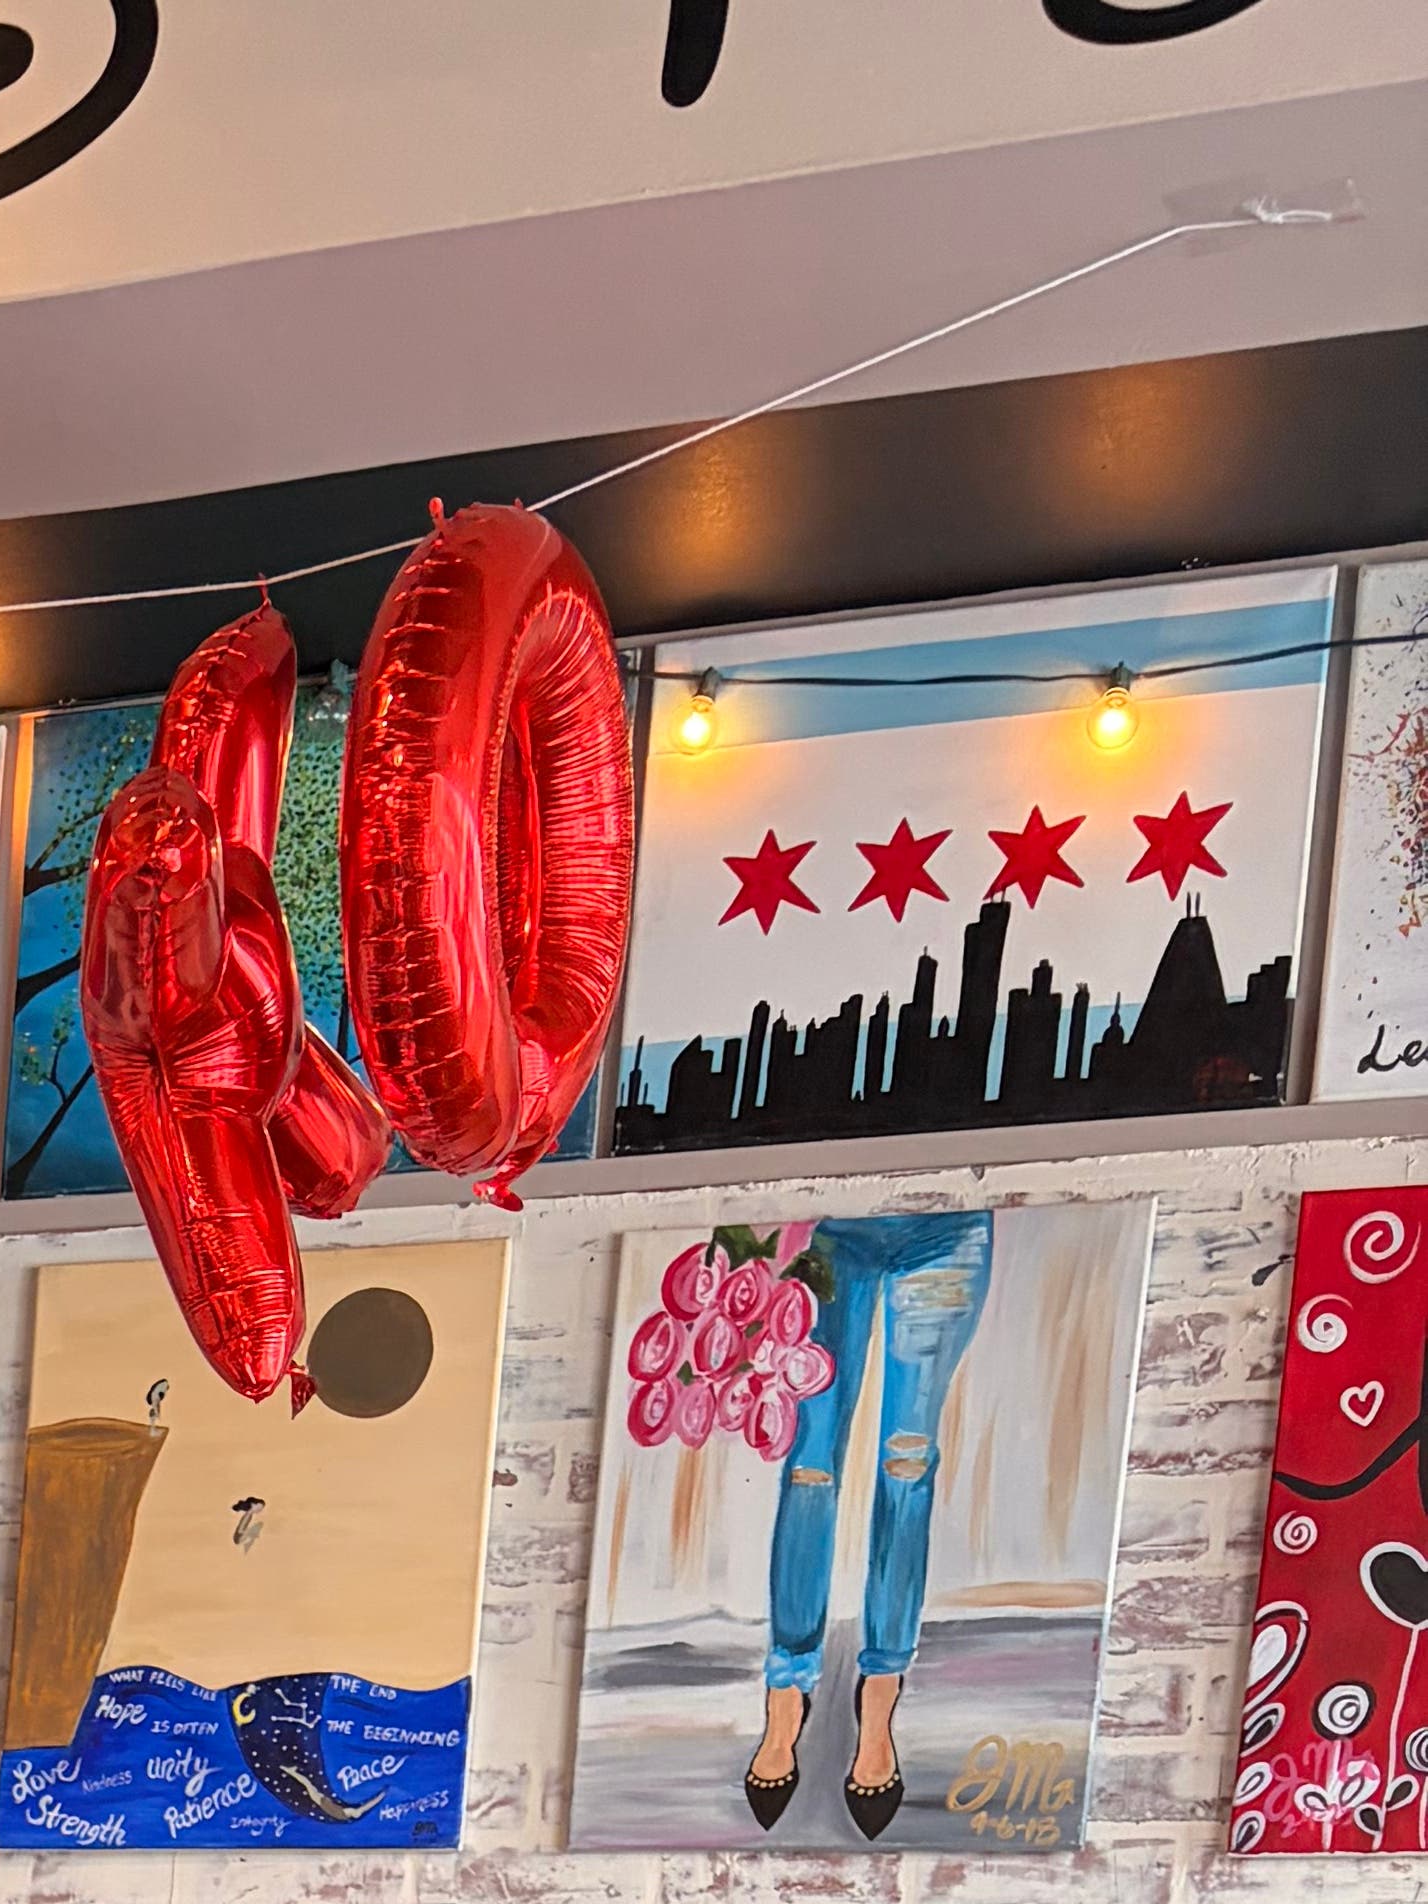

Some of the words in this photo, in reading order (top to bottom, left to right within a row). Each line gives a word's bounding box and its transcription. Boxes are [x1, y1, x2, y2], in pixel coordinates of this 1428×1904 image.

[110, 1670, 145, 1684] WHAT
[330, 1675, 361, 1693] THE
[369, 1685, 397, 1701] END
[95, 1695, 147, 1729] Hope
[151, 1720, 170, 1734] IS
[173, 1722, 219, 1736] OFTEN
[327, 1719, 356, 1735] THE
[363, 1724, 461, 1747] BEGINNING
[12, 1757, 82, 1804] Love
[337, 1754, 409, 1791] Peace
[26, 1795, 127, 1846] Strength
